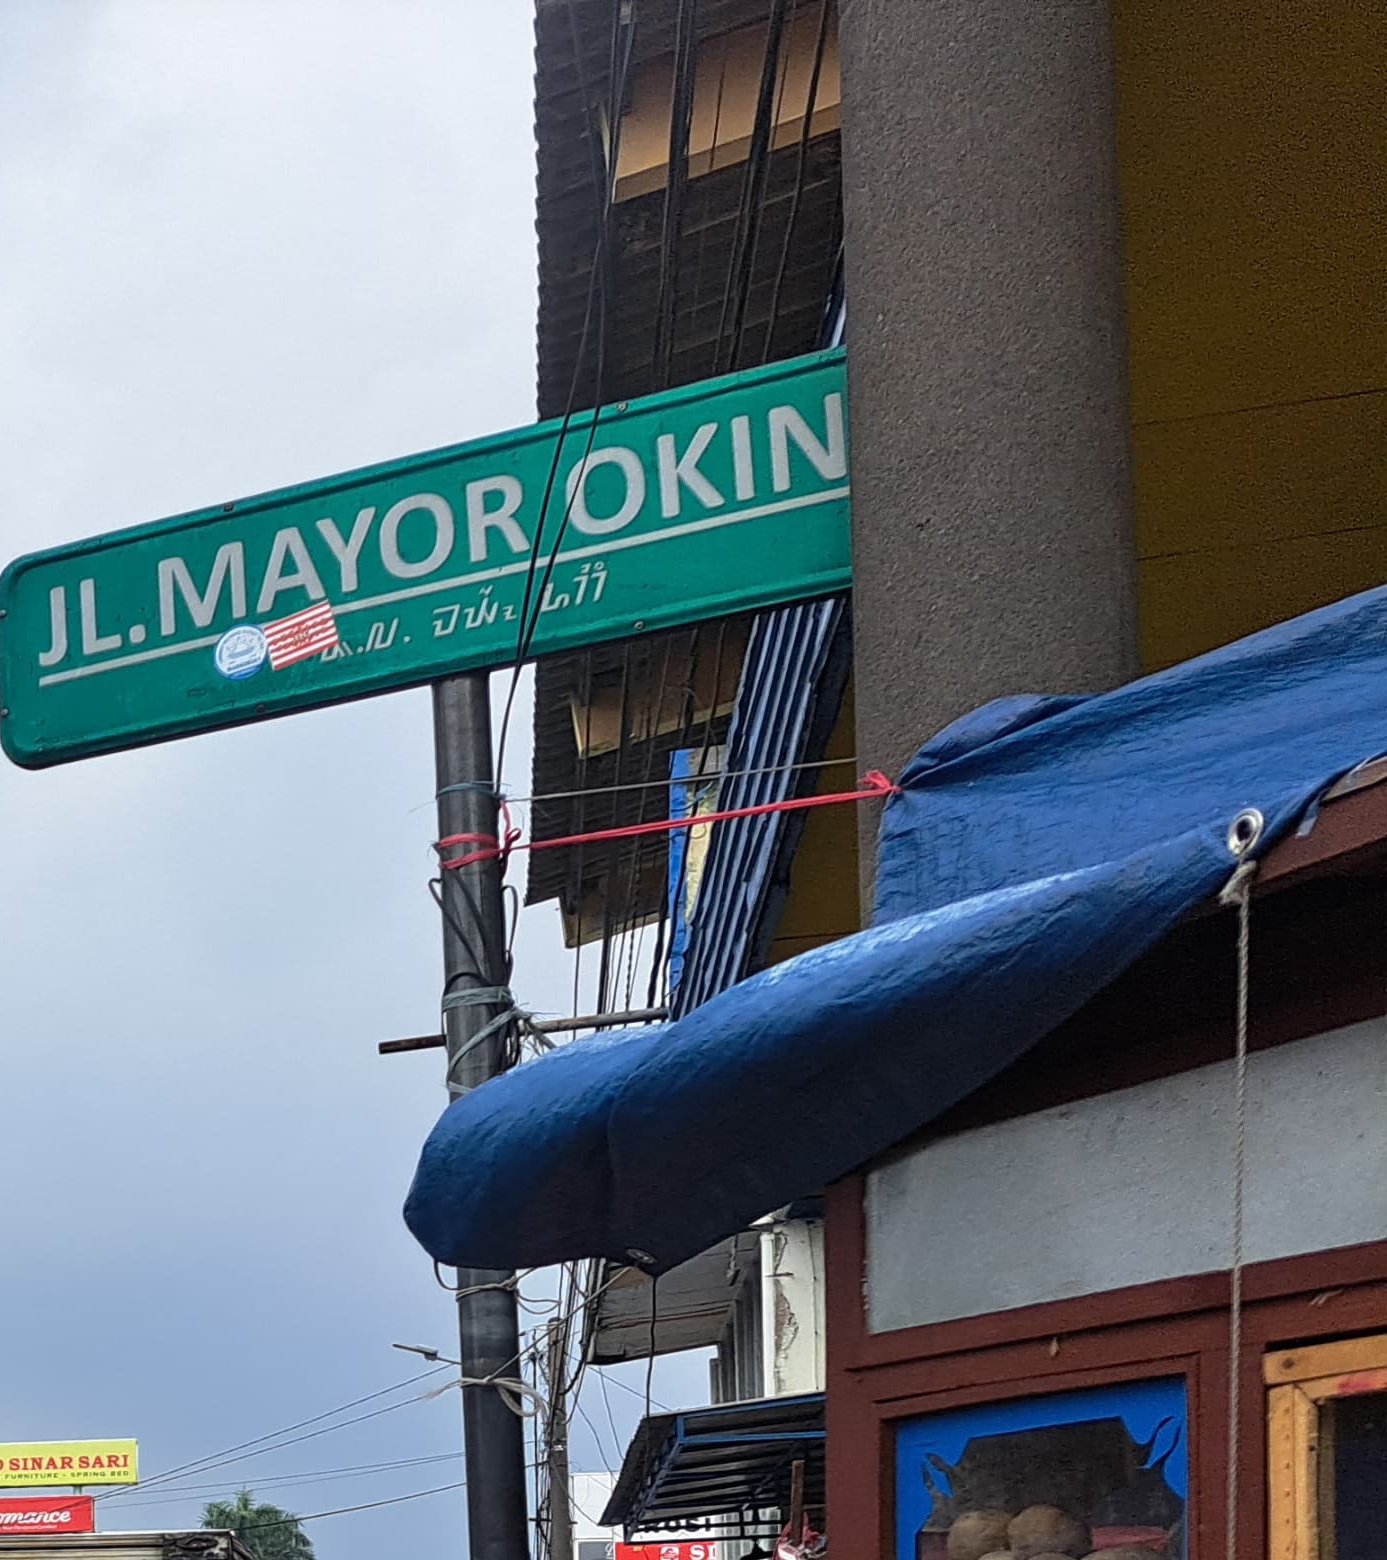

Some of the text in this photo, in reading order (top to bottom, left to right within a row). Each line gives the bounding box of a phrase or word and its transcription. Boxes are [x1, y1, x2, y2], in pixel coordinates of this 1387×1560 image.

[38, 474, 531, 667] JL.MAYOR
[8, 1456, 72, 1471] SINAR
[78, 1454, 129, 1469] SARI
[5, 1472, 59, 1480] FURNITURE
[70, 1470, 106, 1478] SPRING
